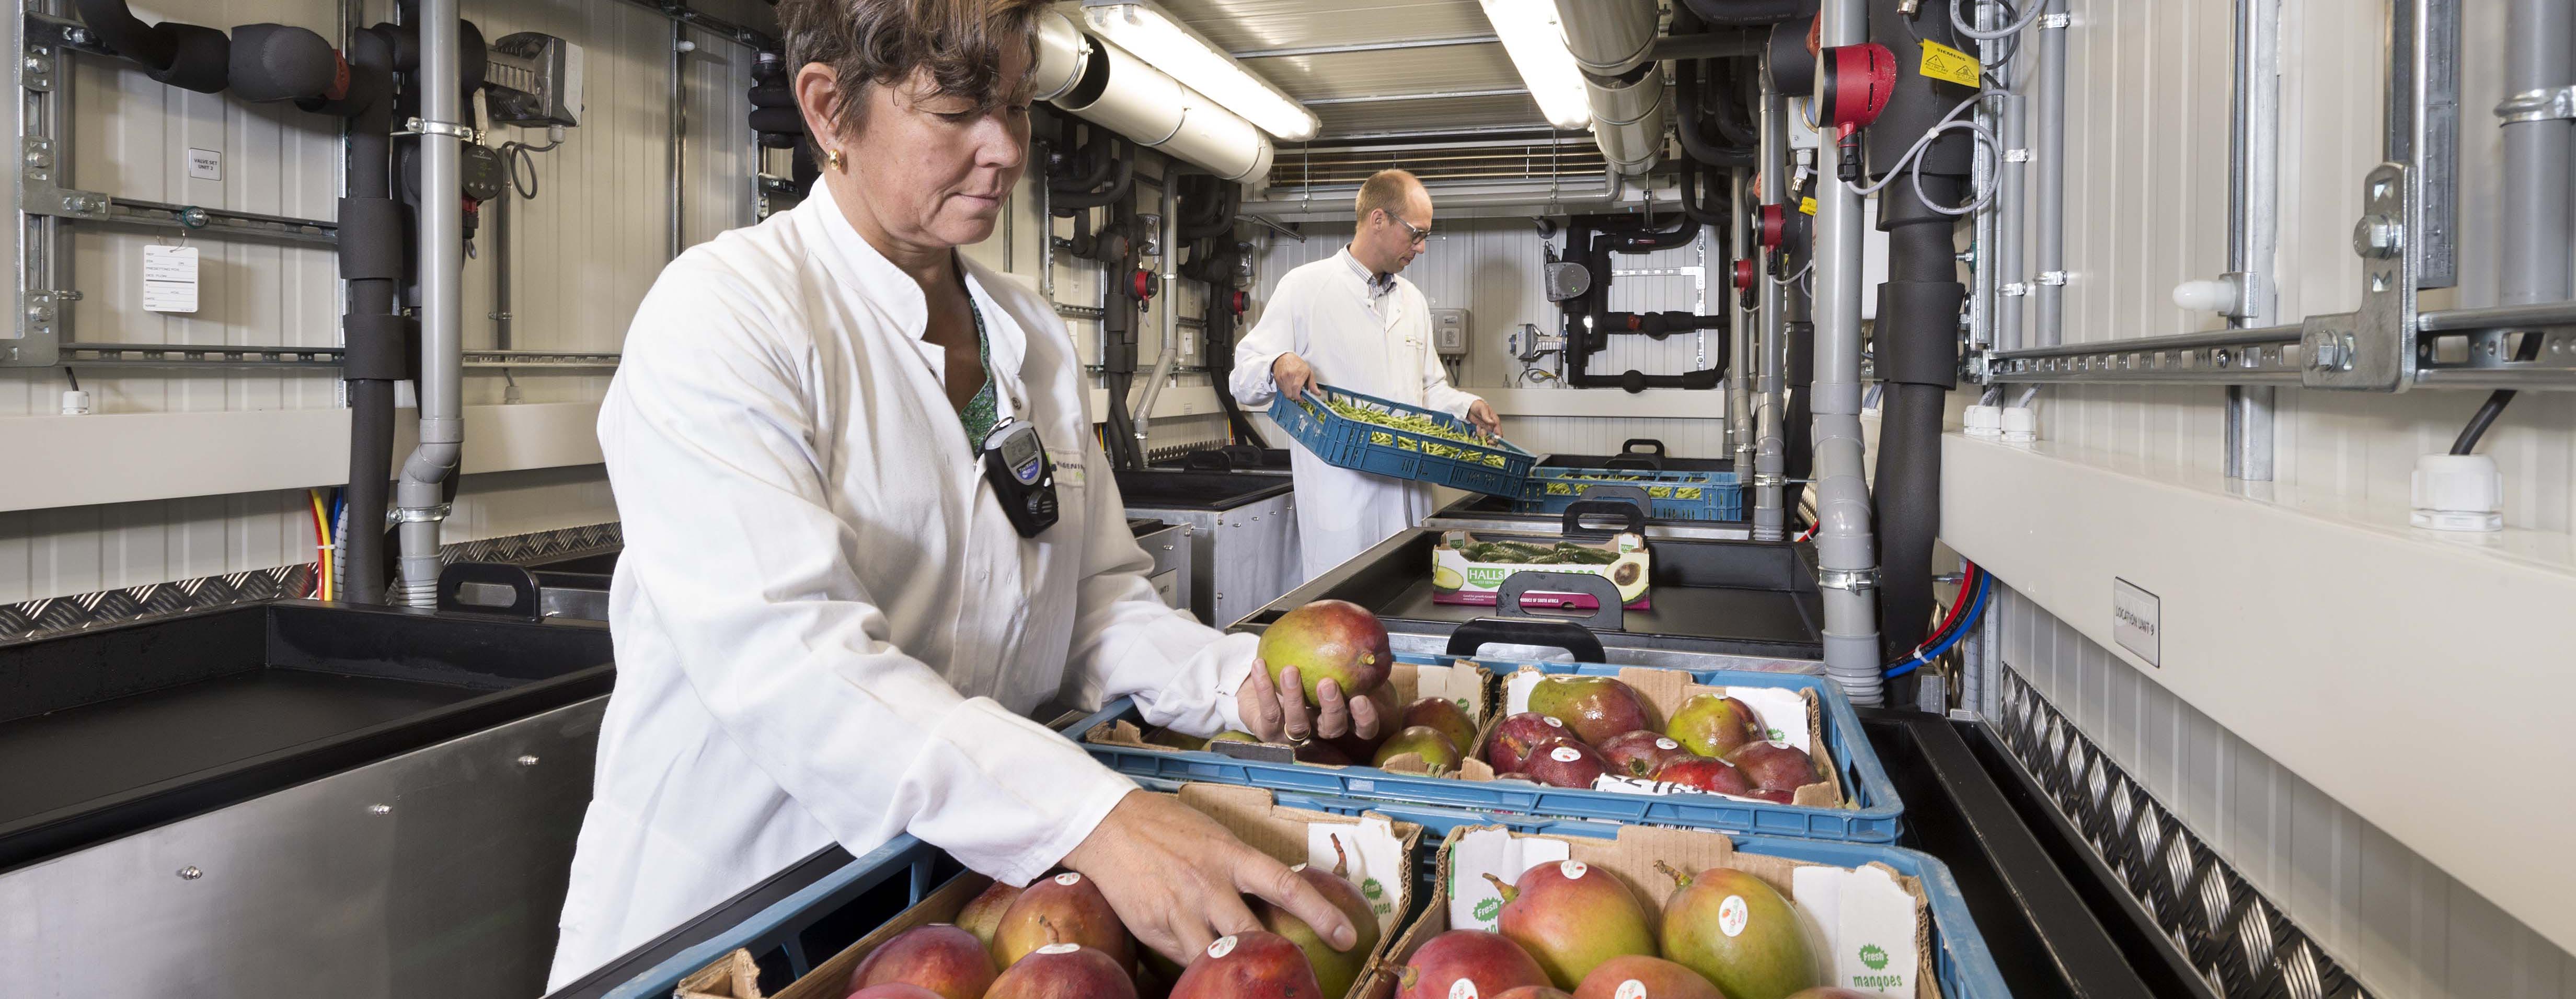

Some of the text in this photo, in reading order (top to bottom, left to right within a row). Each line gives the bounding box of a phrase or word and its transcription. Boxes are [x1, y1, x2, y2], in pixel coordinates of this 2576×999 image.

[1936, 48, 1966, 62] SIEMENS
[1469, 570, 1503, 580] HALLS
[2115, 605, 2154, 636] LOCATION UNIT 9
[1364, 884, 1379, 896] Fresh
[1373, 901, 1392, 920] goes
[1477, 901, 1498, 918] Fresh
[1863, 951, 1885, 962] Fresh
[1852, 974, 1903, 993] mangoes
